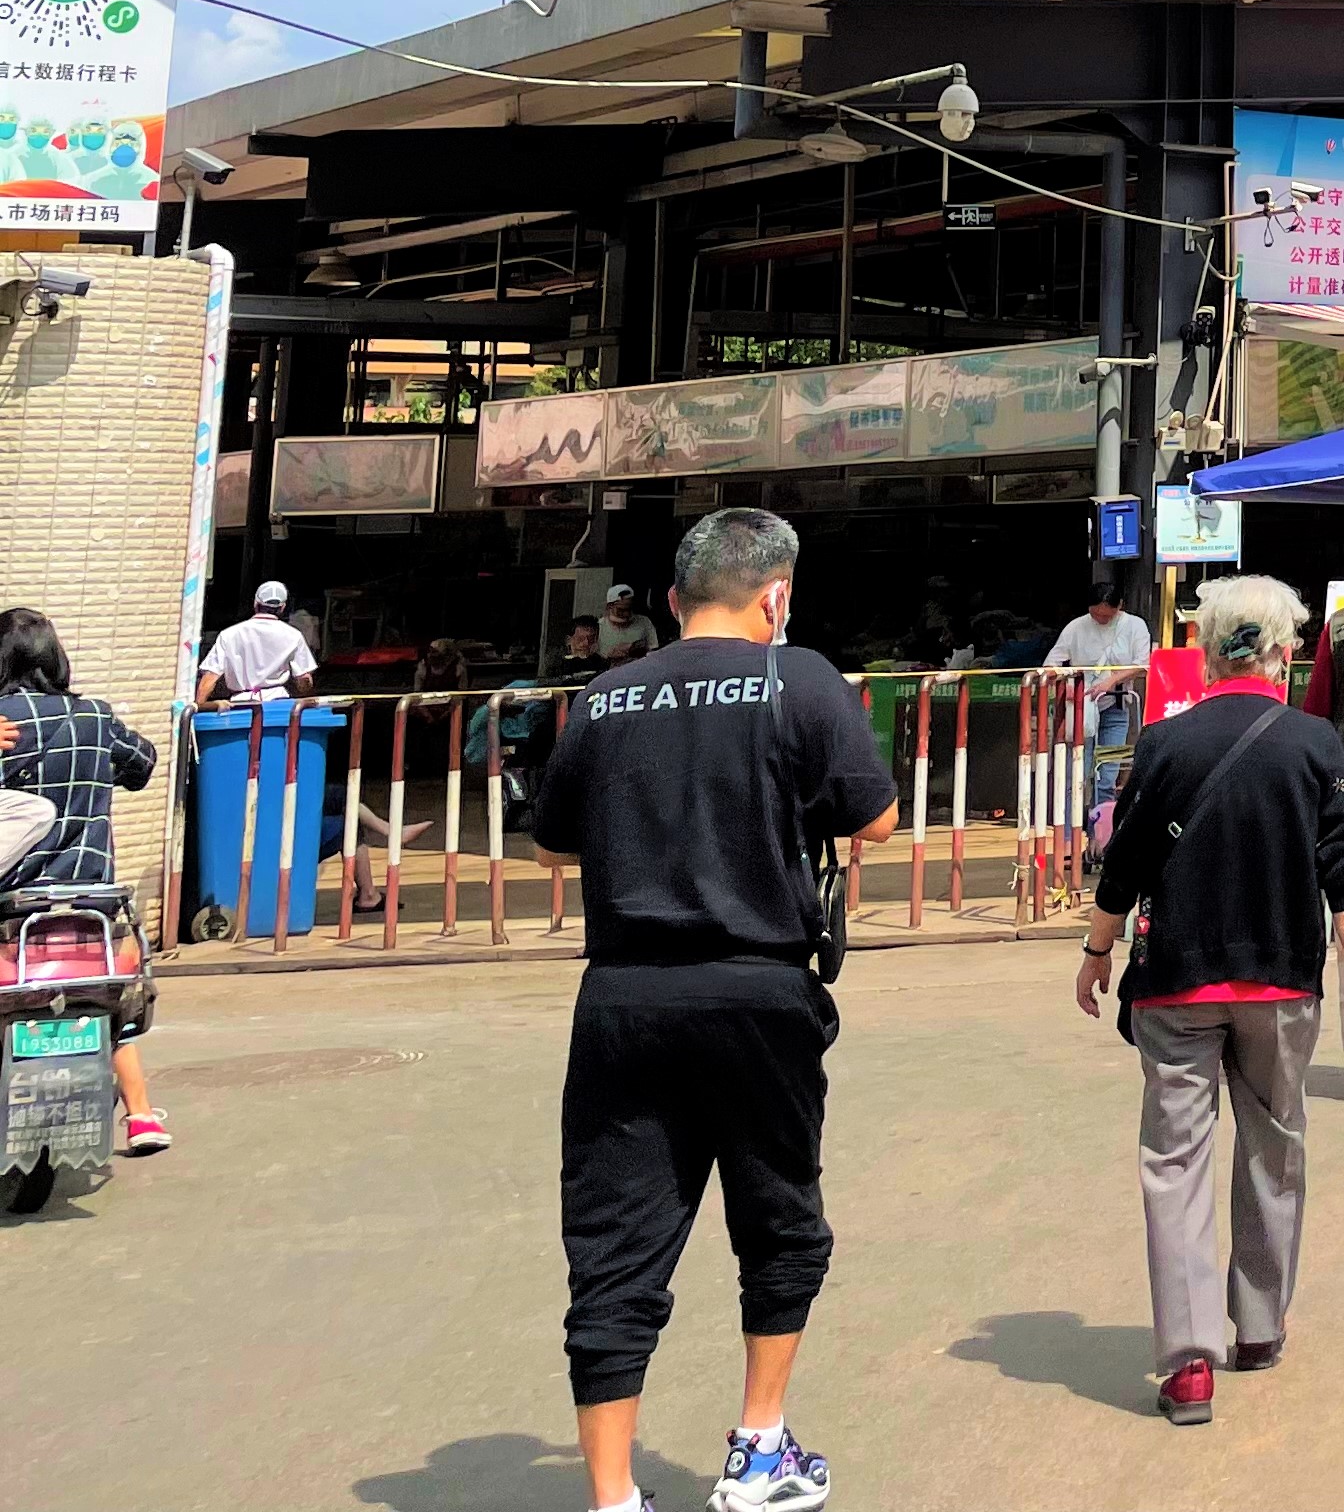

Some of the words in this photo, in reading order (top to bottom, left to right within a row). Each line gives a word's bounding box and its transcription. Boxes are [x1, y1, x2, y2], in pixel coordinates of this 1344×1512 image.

[0, 204, 120, 223] 市场请扫码
[588, 686, 647, 721] BEE
[651, 683, 679, 710] A
